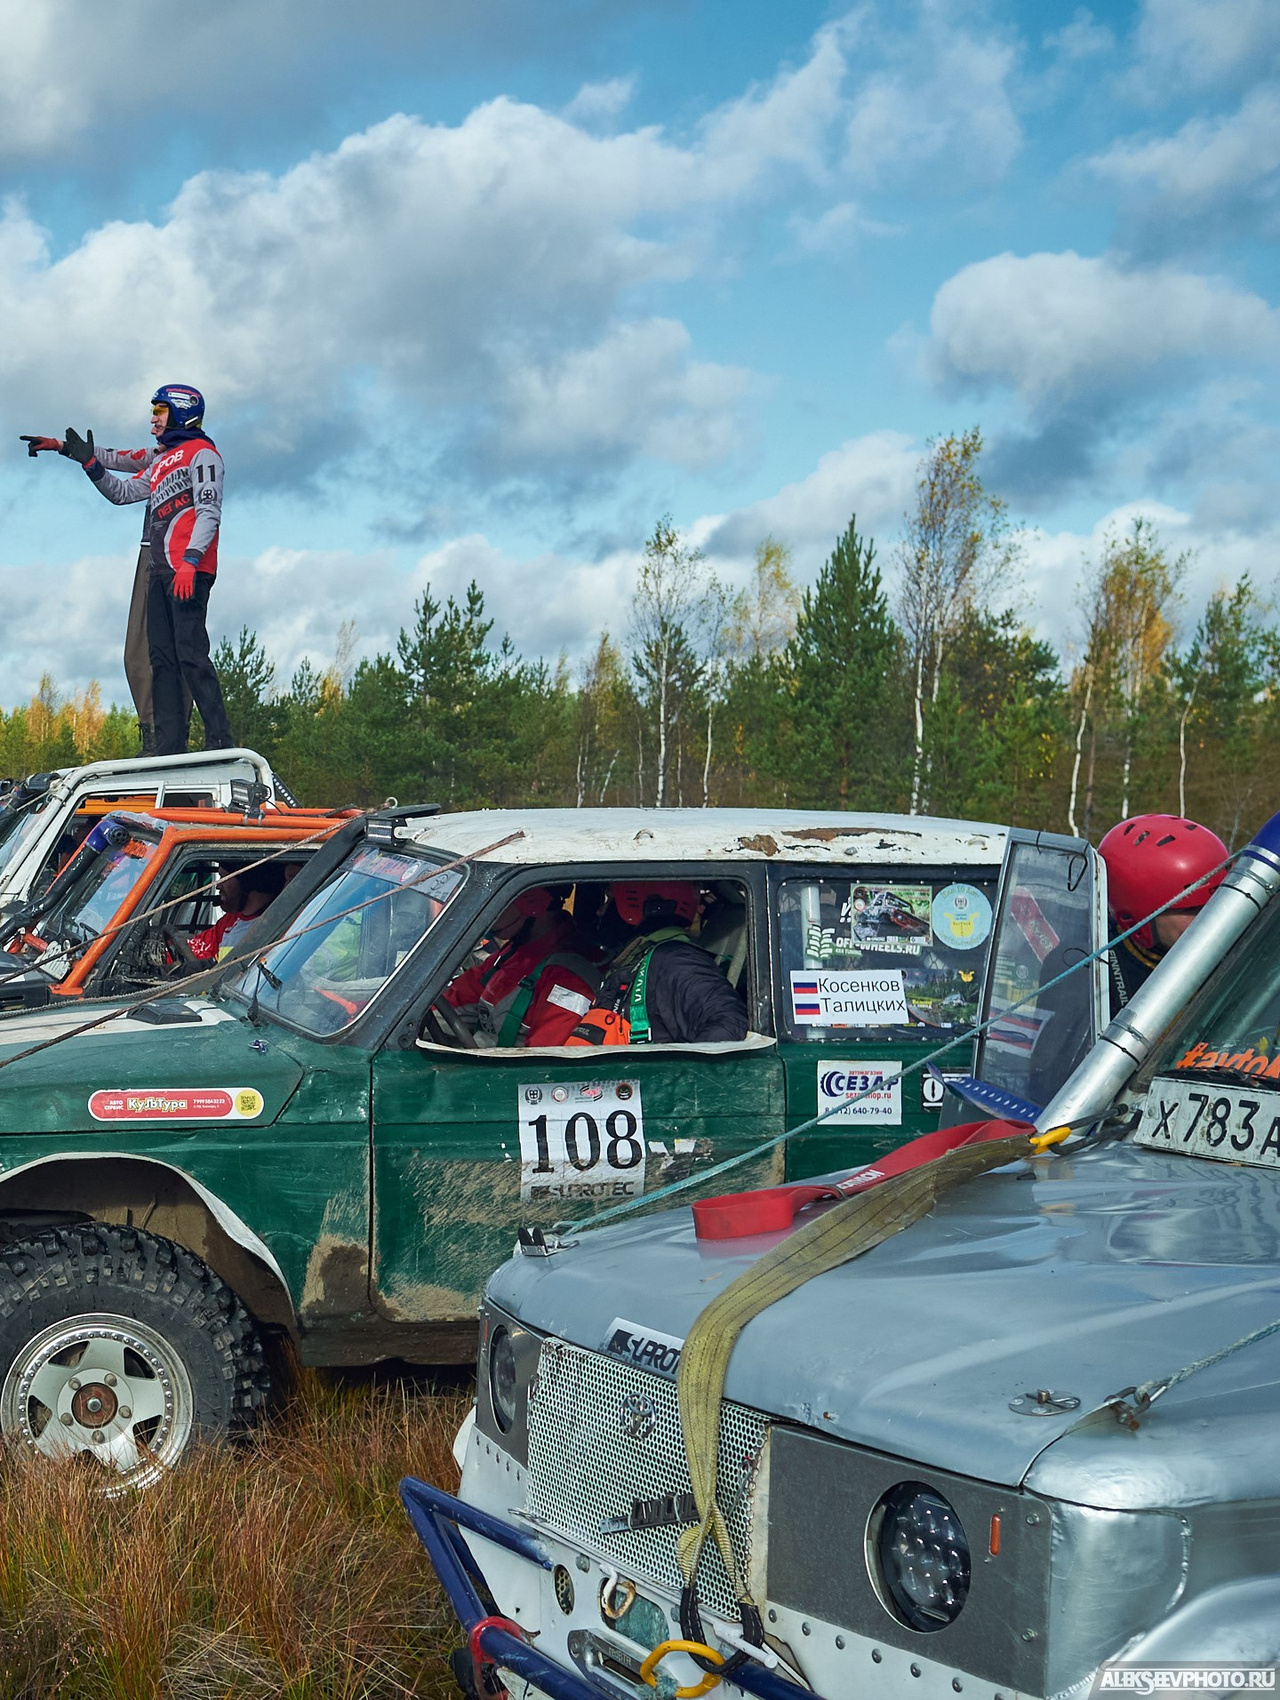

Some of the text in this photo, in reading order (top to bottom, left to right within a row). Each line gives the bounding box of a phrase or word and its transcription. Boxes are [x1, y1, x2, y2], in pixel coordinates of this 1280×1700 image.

[196, 464, 216, 483] 11
[157, 493, 190, 519] ПЕГАС
[818, 978, 900, 993] Косенков
[1109, 949, 1129, 1006] FINNTRAIL
[820, 998, 906, 1014] Талицких
[852, 1107, 892, 1115] 640-79-40
[528, 1109, 642, 1174] 108
